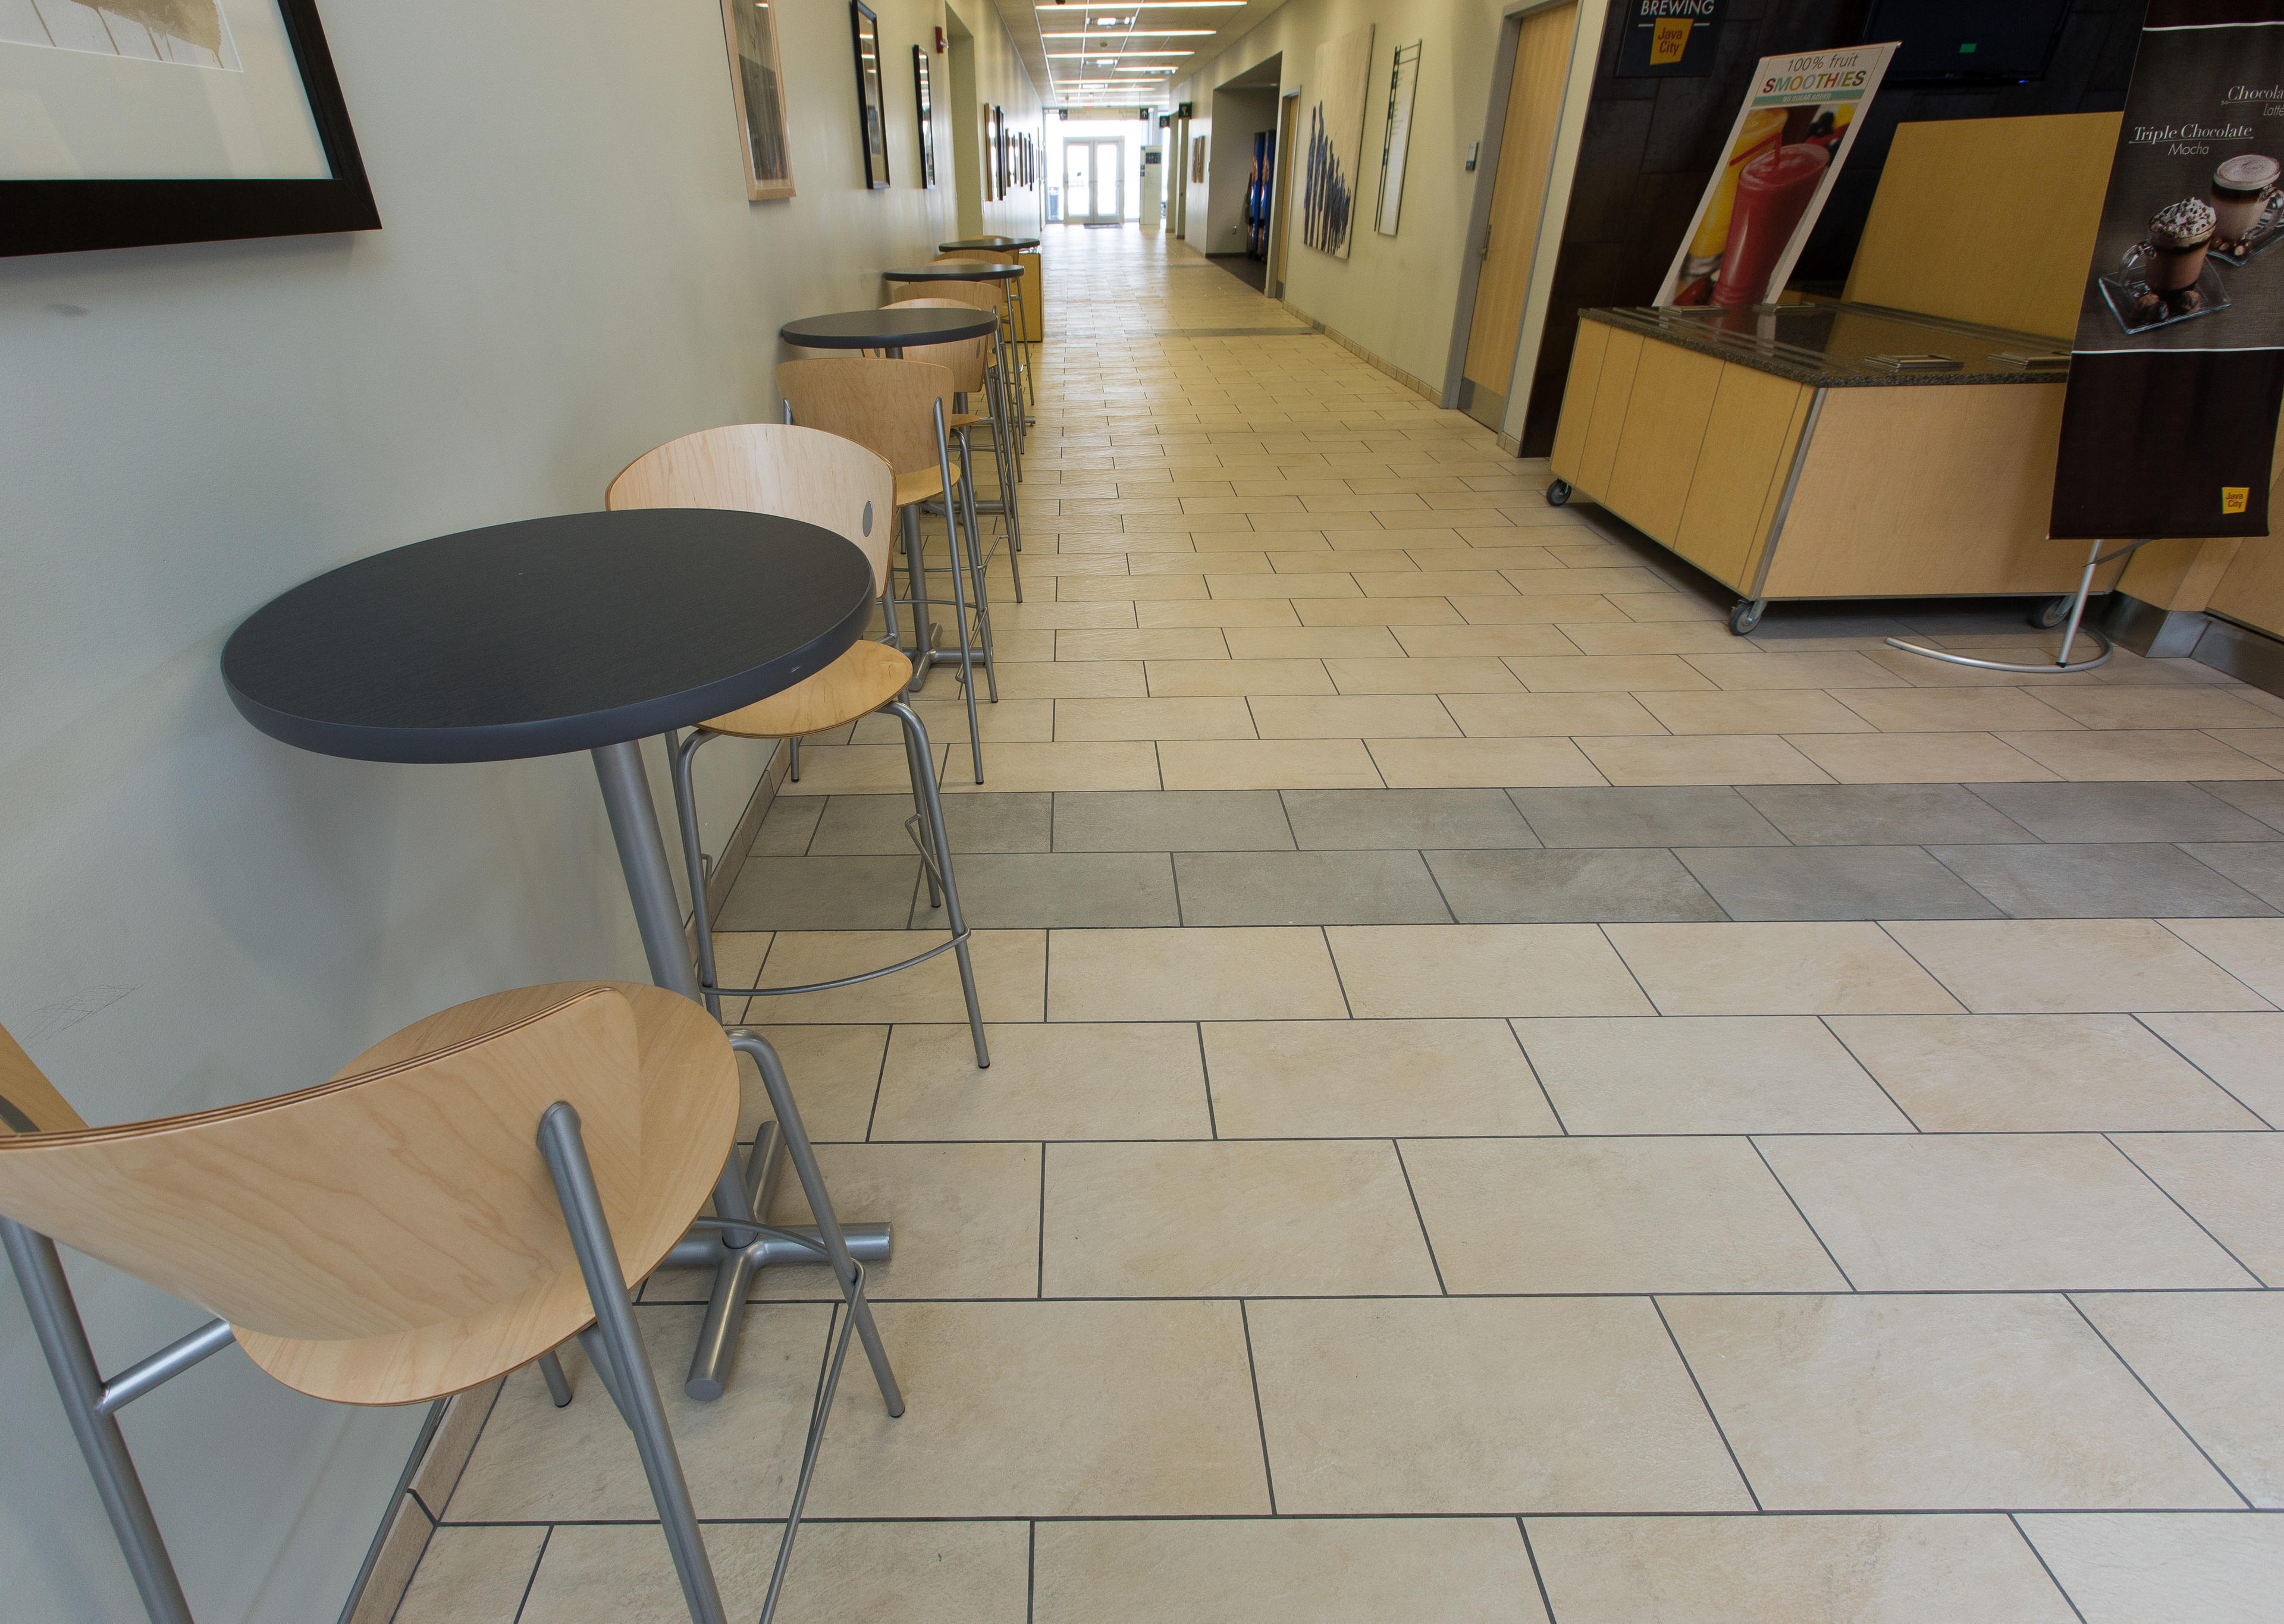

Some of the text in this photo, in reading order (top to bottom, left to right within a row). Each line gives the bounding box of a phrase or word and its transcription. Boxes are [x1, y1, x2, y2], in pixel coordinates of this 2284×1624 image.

[1640, 0, 1714, 15] BREWING
[1658, 27, 1683, 40] Java
[1659, 41, 1680, 56] City
[1787, 52, 1859, 73] 100% fruit
[1763, 70, 1867, 94] SMOOTHIES
[2134, 123, 2252, 145] Triple Chocolate
[2167, 142, 2210, 156] Mocha
[2227, 500, 2244, 509] City
